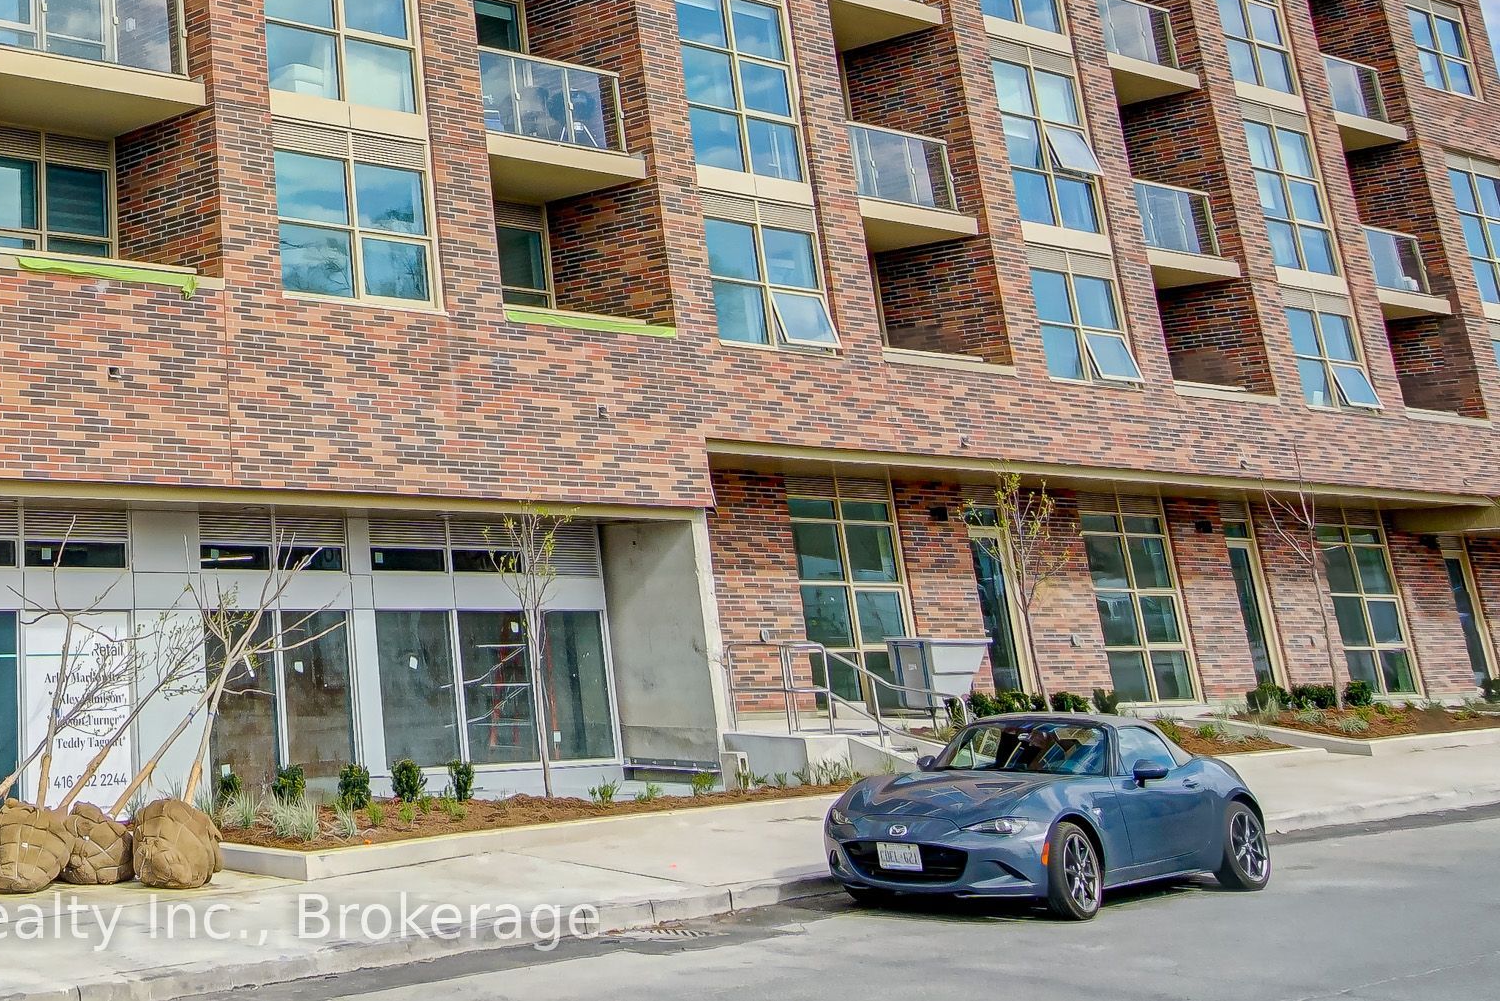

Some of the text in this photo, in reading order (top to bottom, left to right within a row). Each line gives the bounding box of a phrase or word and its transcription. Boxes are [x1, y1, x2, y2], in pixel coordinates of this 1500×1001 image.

[91, 642, 123, 657] Retail
[56, 737, 86, 751] Teddy
[53, 774, 74, 789] 416
[100, 772, 127, 787] 2244
